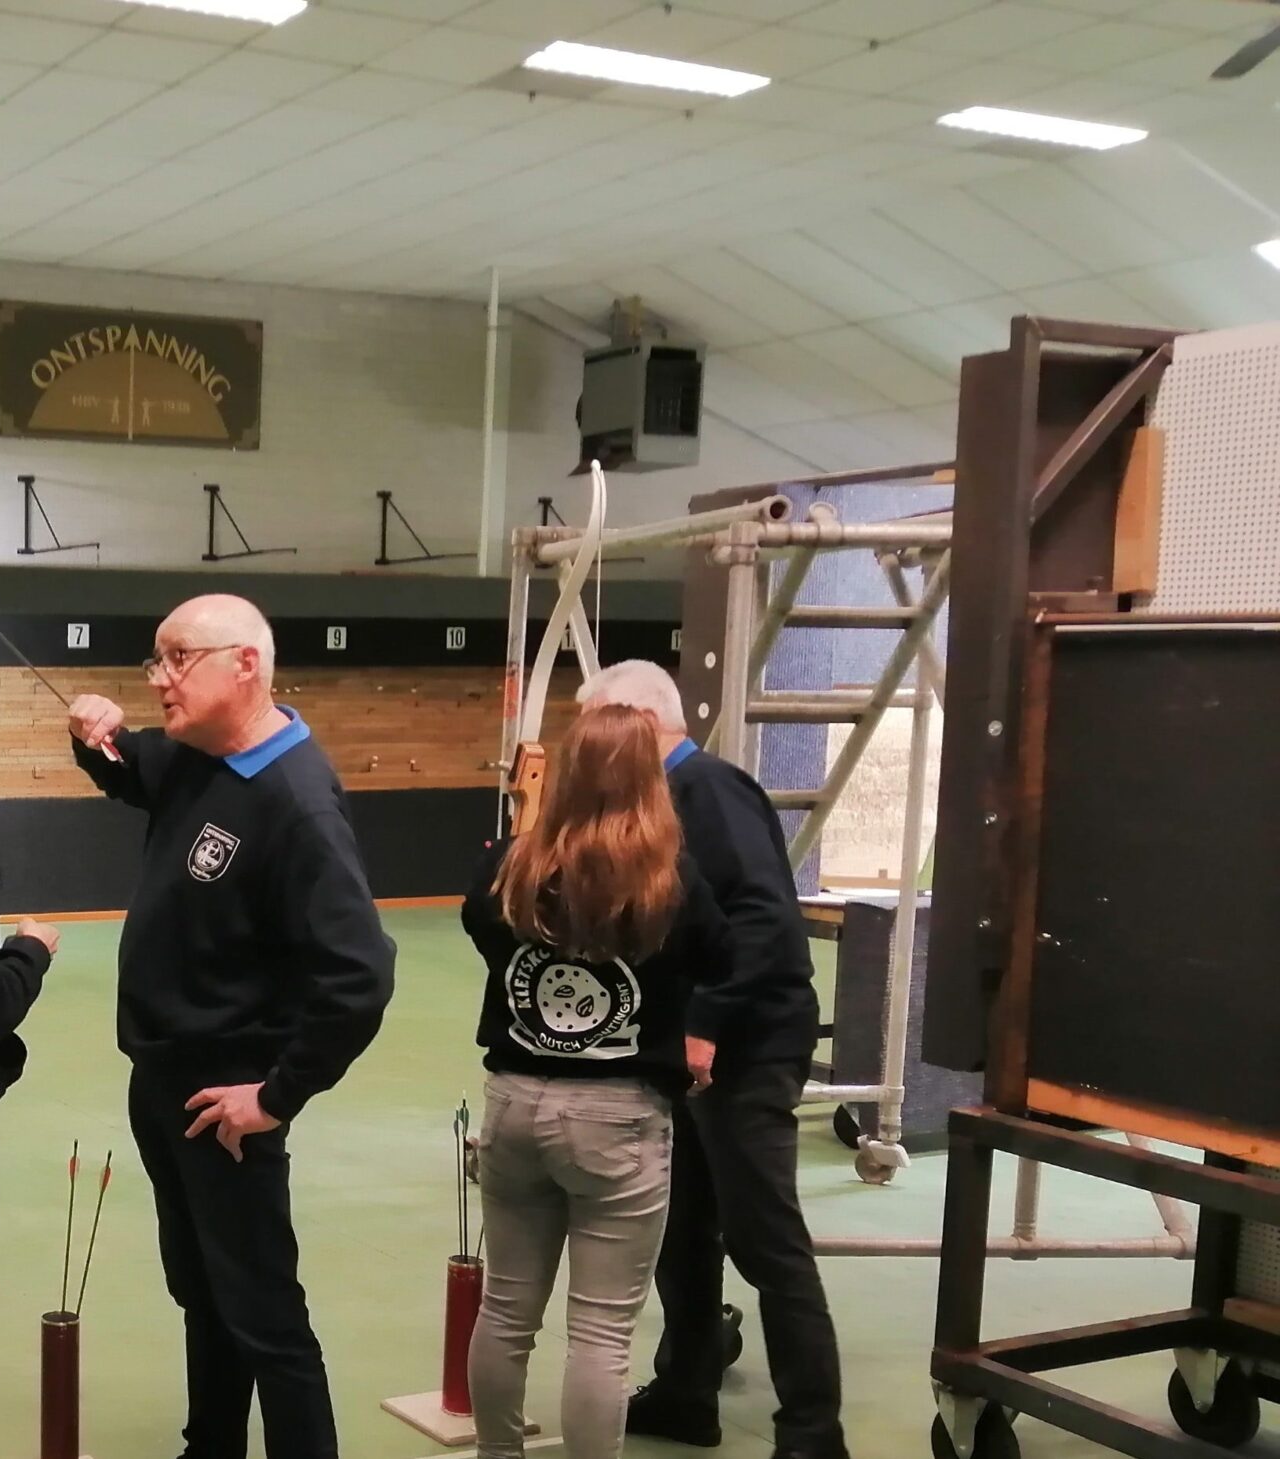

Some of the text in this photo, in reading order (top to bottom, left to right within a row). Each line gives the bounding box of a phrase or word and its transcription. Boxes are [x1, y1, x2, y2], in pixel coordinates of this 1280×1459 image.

[31, 324, 232, 402] ONTSPANNING
[74, 625, 84, 645] 7
[333, 628, 342, 648] 9
[449, 629, 464, 648] 10
[540, 982, 632, 1051] DUTCH CONTINGENT
